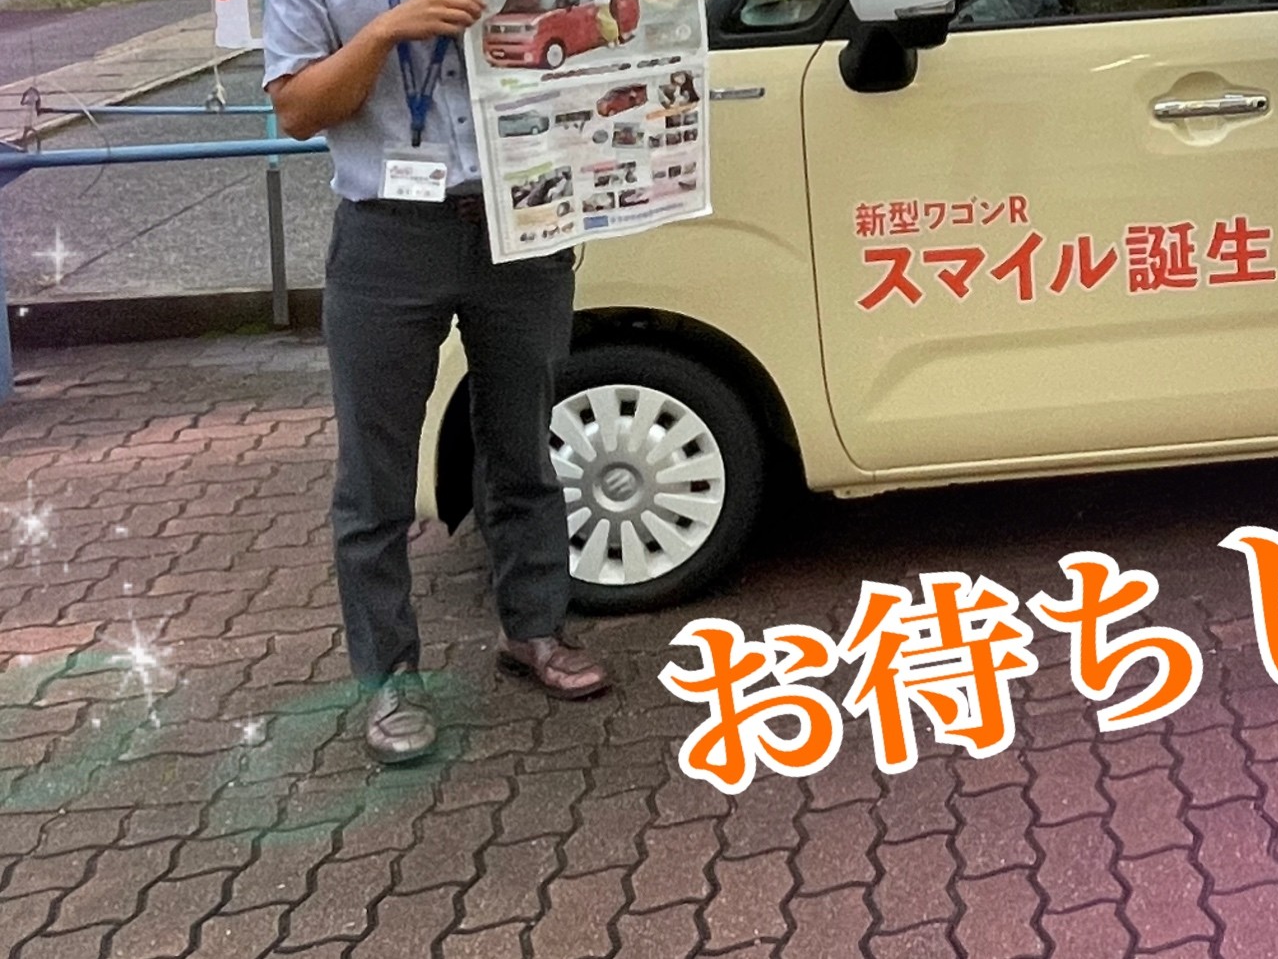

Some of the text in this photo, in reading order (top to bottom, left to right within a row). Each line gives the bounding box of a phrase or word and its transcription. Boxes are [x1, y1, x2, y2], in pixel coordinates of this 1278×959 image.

[855, 195, 1028, 237] 新型ワゴンR
[858, 217, 1276, 310] スマイル誕生
